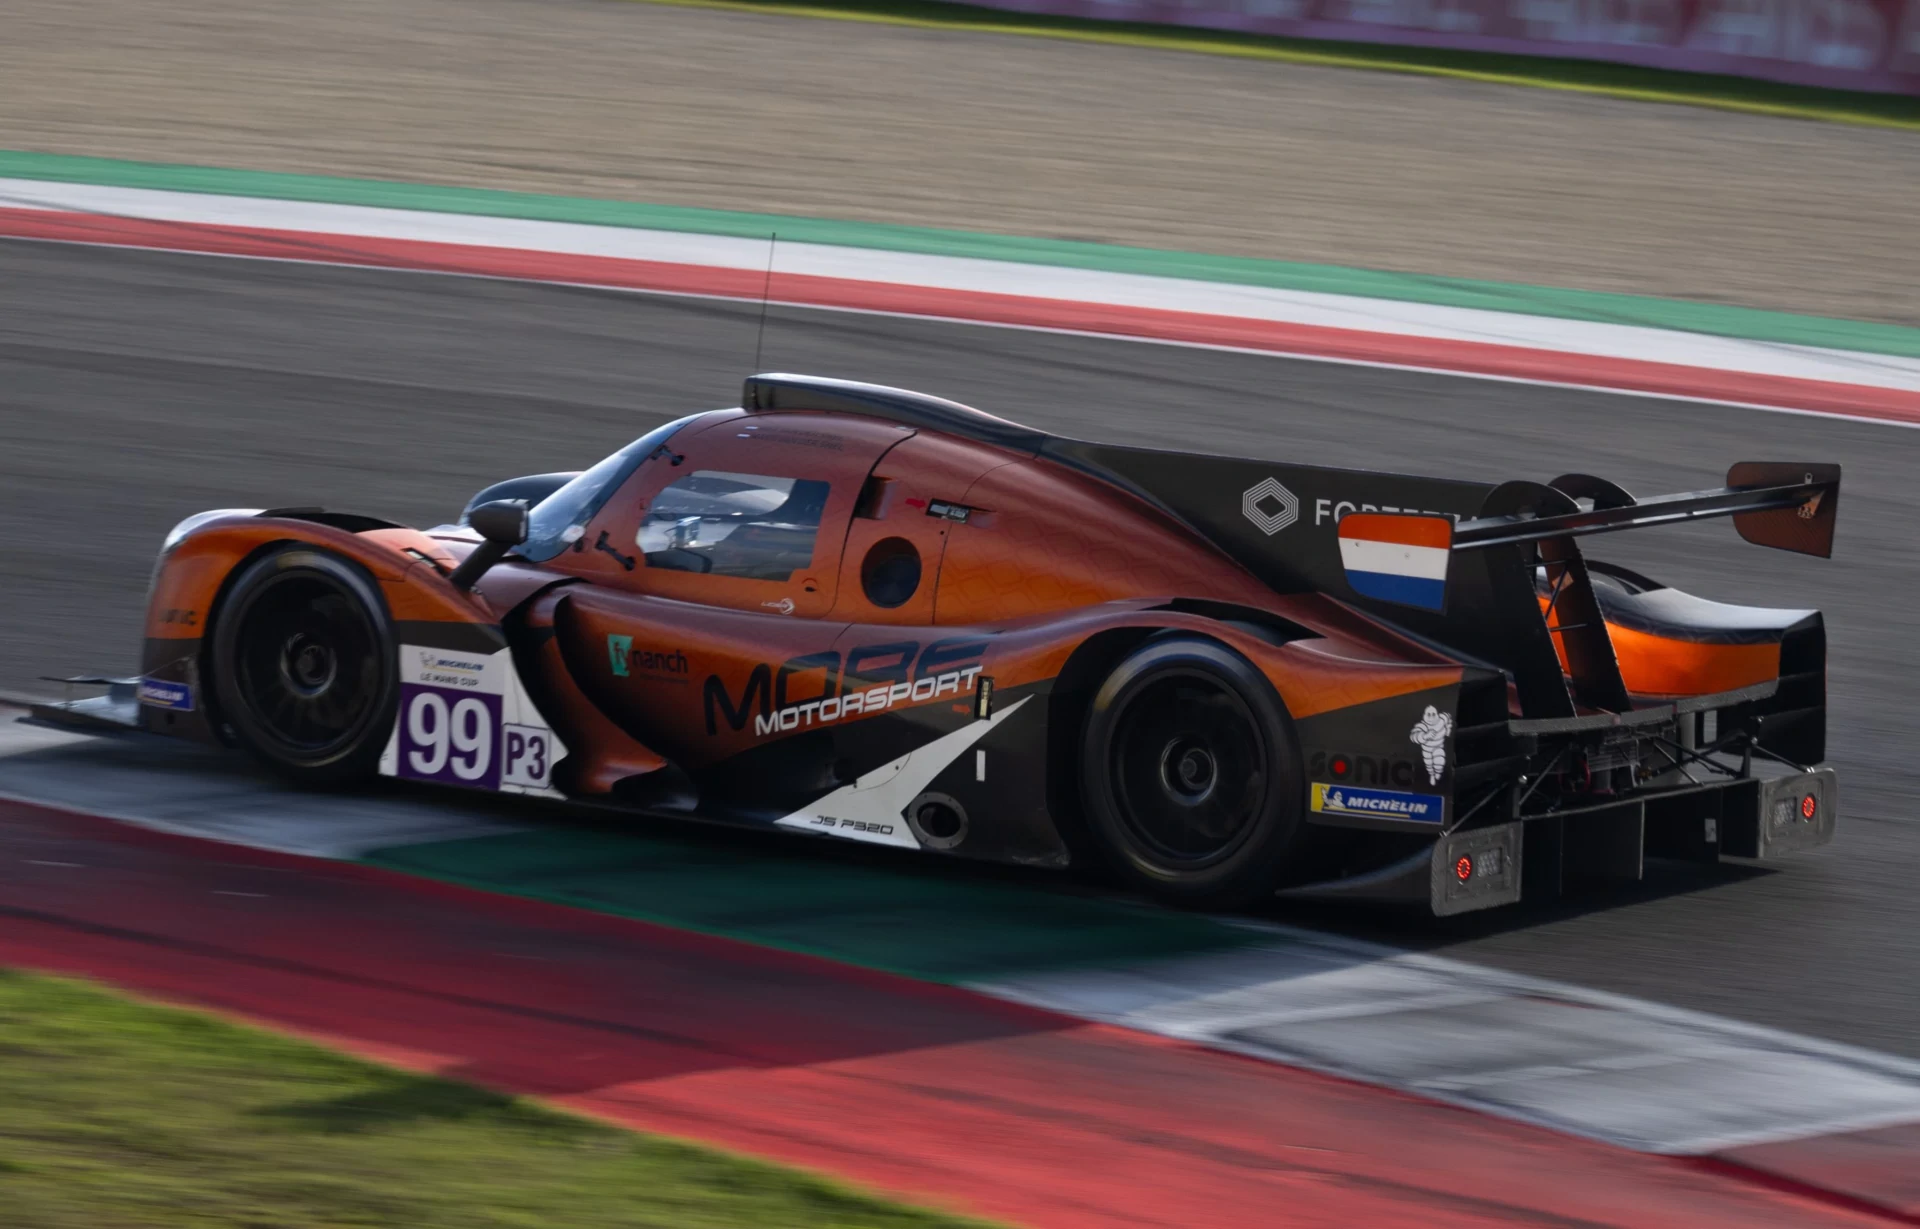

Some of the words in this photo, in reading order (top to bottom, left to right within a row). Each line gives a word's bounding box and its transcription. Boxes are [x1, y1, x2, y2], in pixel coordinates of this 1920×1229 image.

[420, 672, 433, 681] LE
[460, 677, 479, 687] CUP
[754, 666, 984, 736] MOTORSPORT
[407, 692, 492, 781] 99
[504, 731, 546, 780] P3
[1347, 796, 1429, 814] MICHELIN
[810, 815, 838, 828] JS
[841, 818, 894, 835] P320
